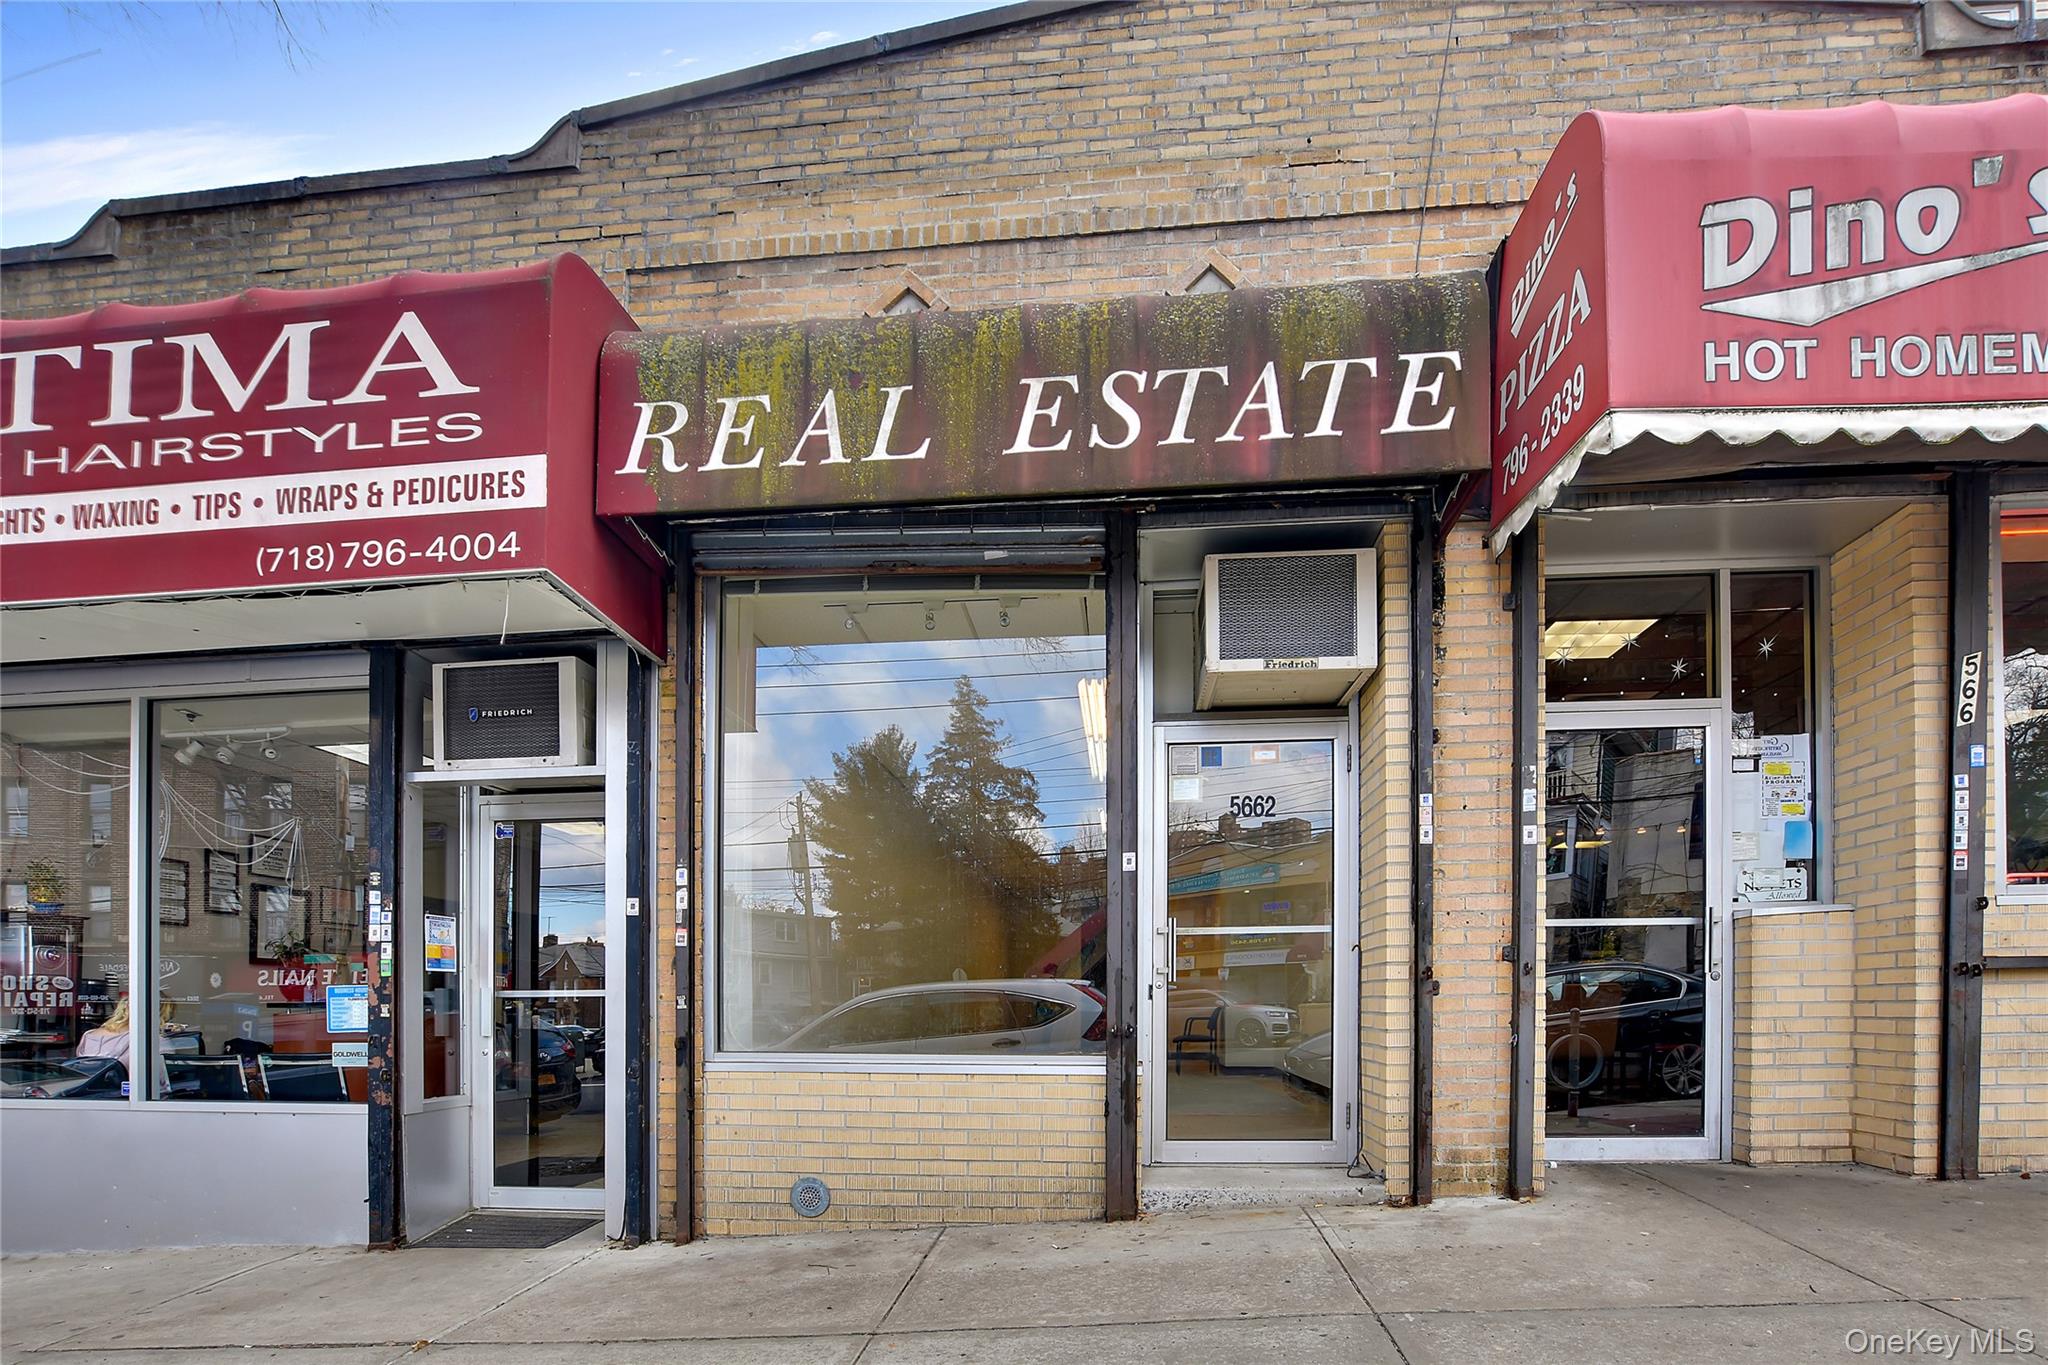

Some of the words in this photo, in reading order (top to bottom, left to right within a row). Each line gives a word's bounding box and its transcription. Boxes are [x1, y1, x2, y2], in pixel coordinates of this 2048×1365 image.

[1510, 171, 1578, 321] Dino's
[0, 311, 481, 435] TIMA
[1498, 268, 1592, 435] PIZZA
[1704, 338, 1818, 382] HOT
[23, 412, 484, 477] HAIRSTYLES
[614, 383, 932, 477] REAL
[1002, 350, 1463, 457] ESTATE
[1502, 363, 1585, 495] 796-2339
[72, 498, 160, 531] WAXING
[192, 492, 242, 521] TIPS
[276, 482, 358, 515] WRAPS
[367, 482, 384, 508] &
[392, 469, 526, 506] PEDICURES
[1265, 659, 1317, 669] Friedrich
[481, 708, 533, 718] FRIEDRICH
[1230, 795, 1276, 818] 5662
